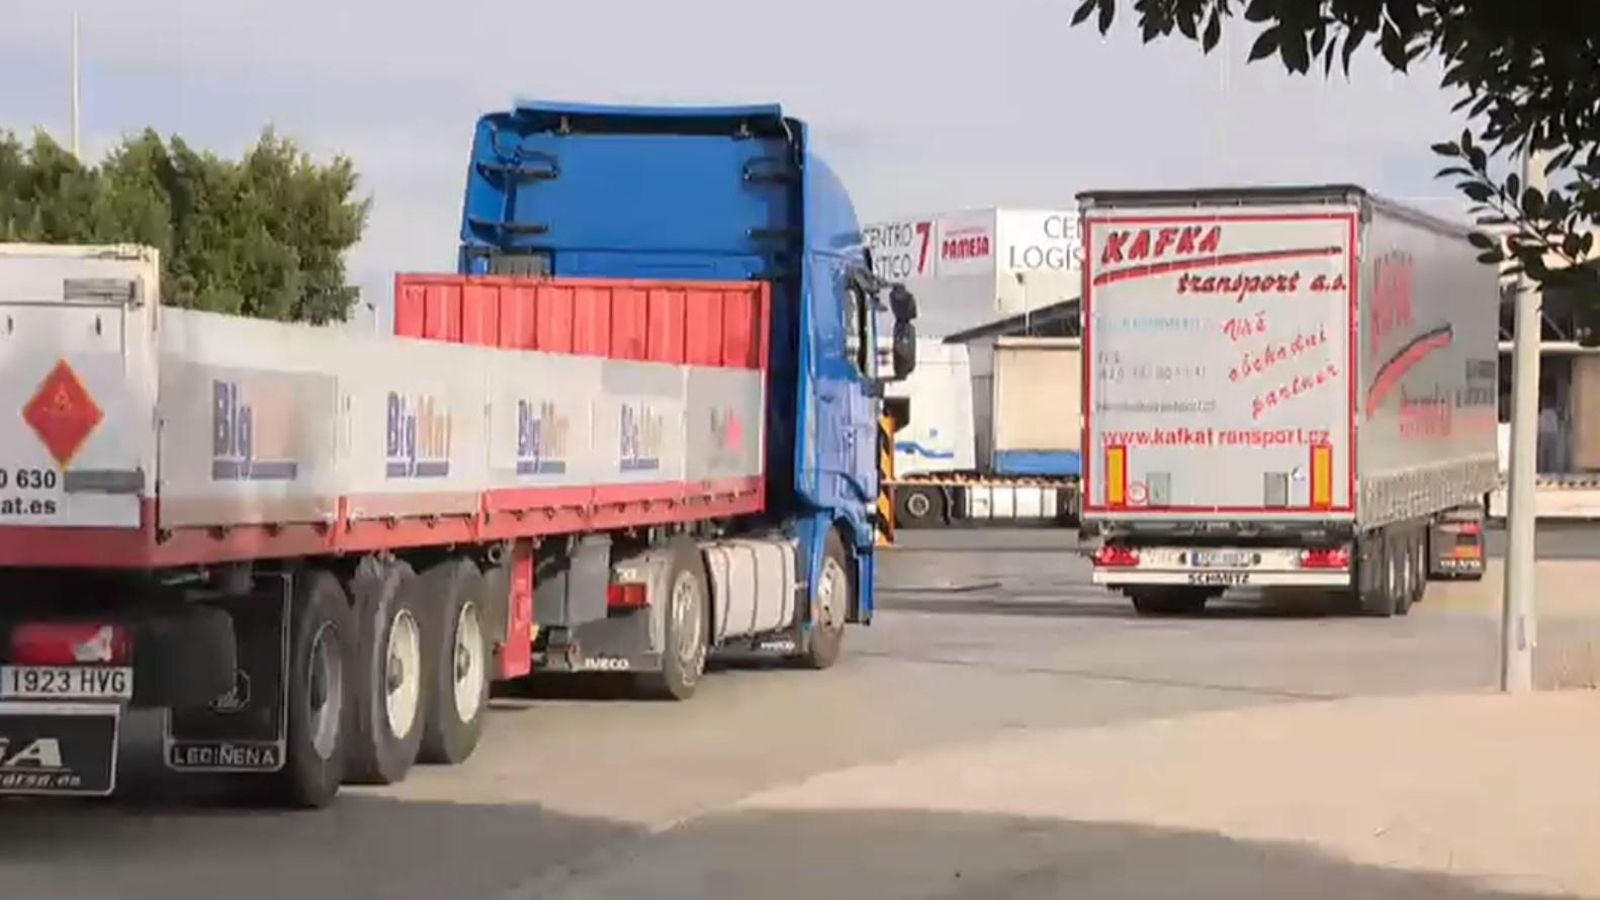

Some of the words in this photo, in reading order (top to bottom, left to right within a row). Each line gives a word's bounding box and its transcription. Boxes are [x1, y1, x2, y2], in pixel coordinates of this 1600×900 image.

[916, 222, 932, 275] 7
[1101, 226, 1221, 264] KAFKA
[1177, 272, 1300, 303] transport
[16, 468, 57, 489] 630
[585, 657, 629, 670] IVECO
[12, 669, 71, 693] 1923
[81, 669, 126, 693] HVG
[0, 737, 63, 767] A
